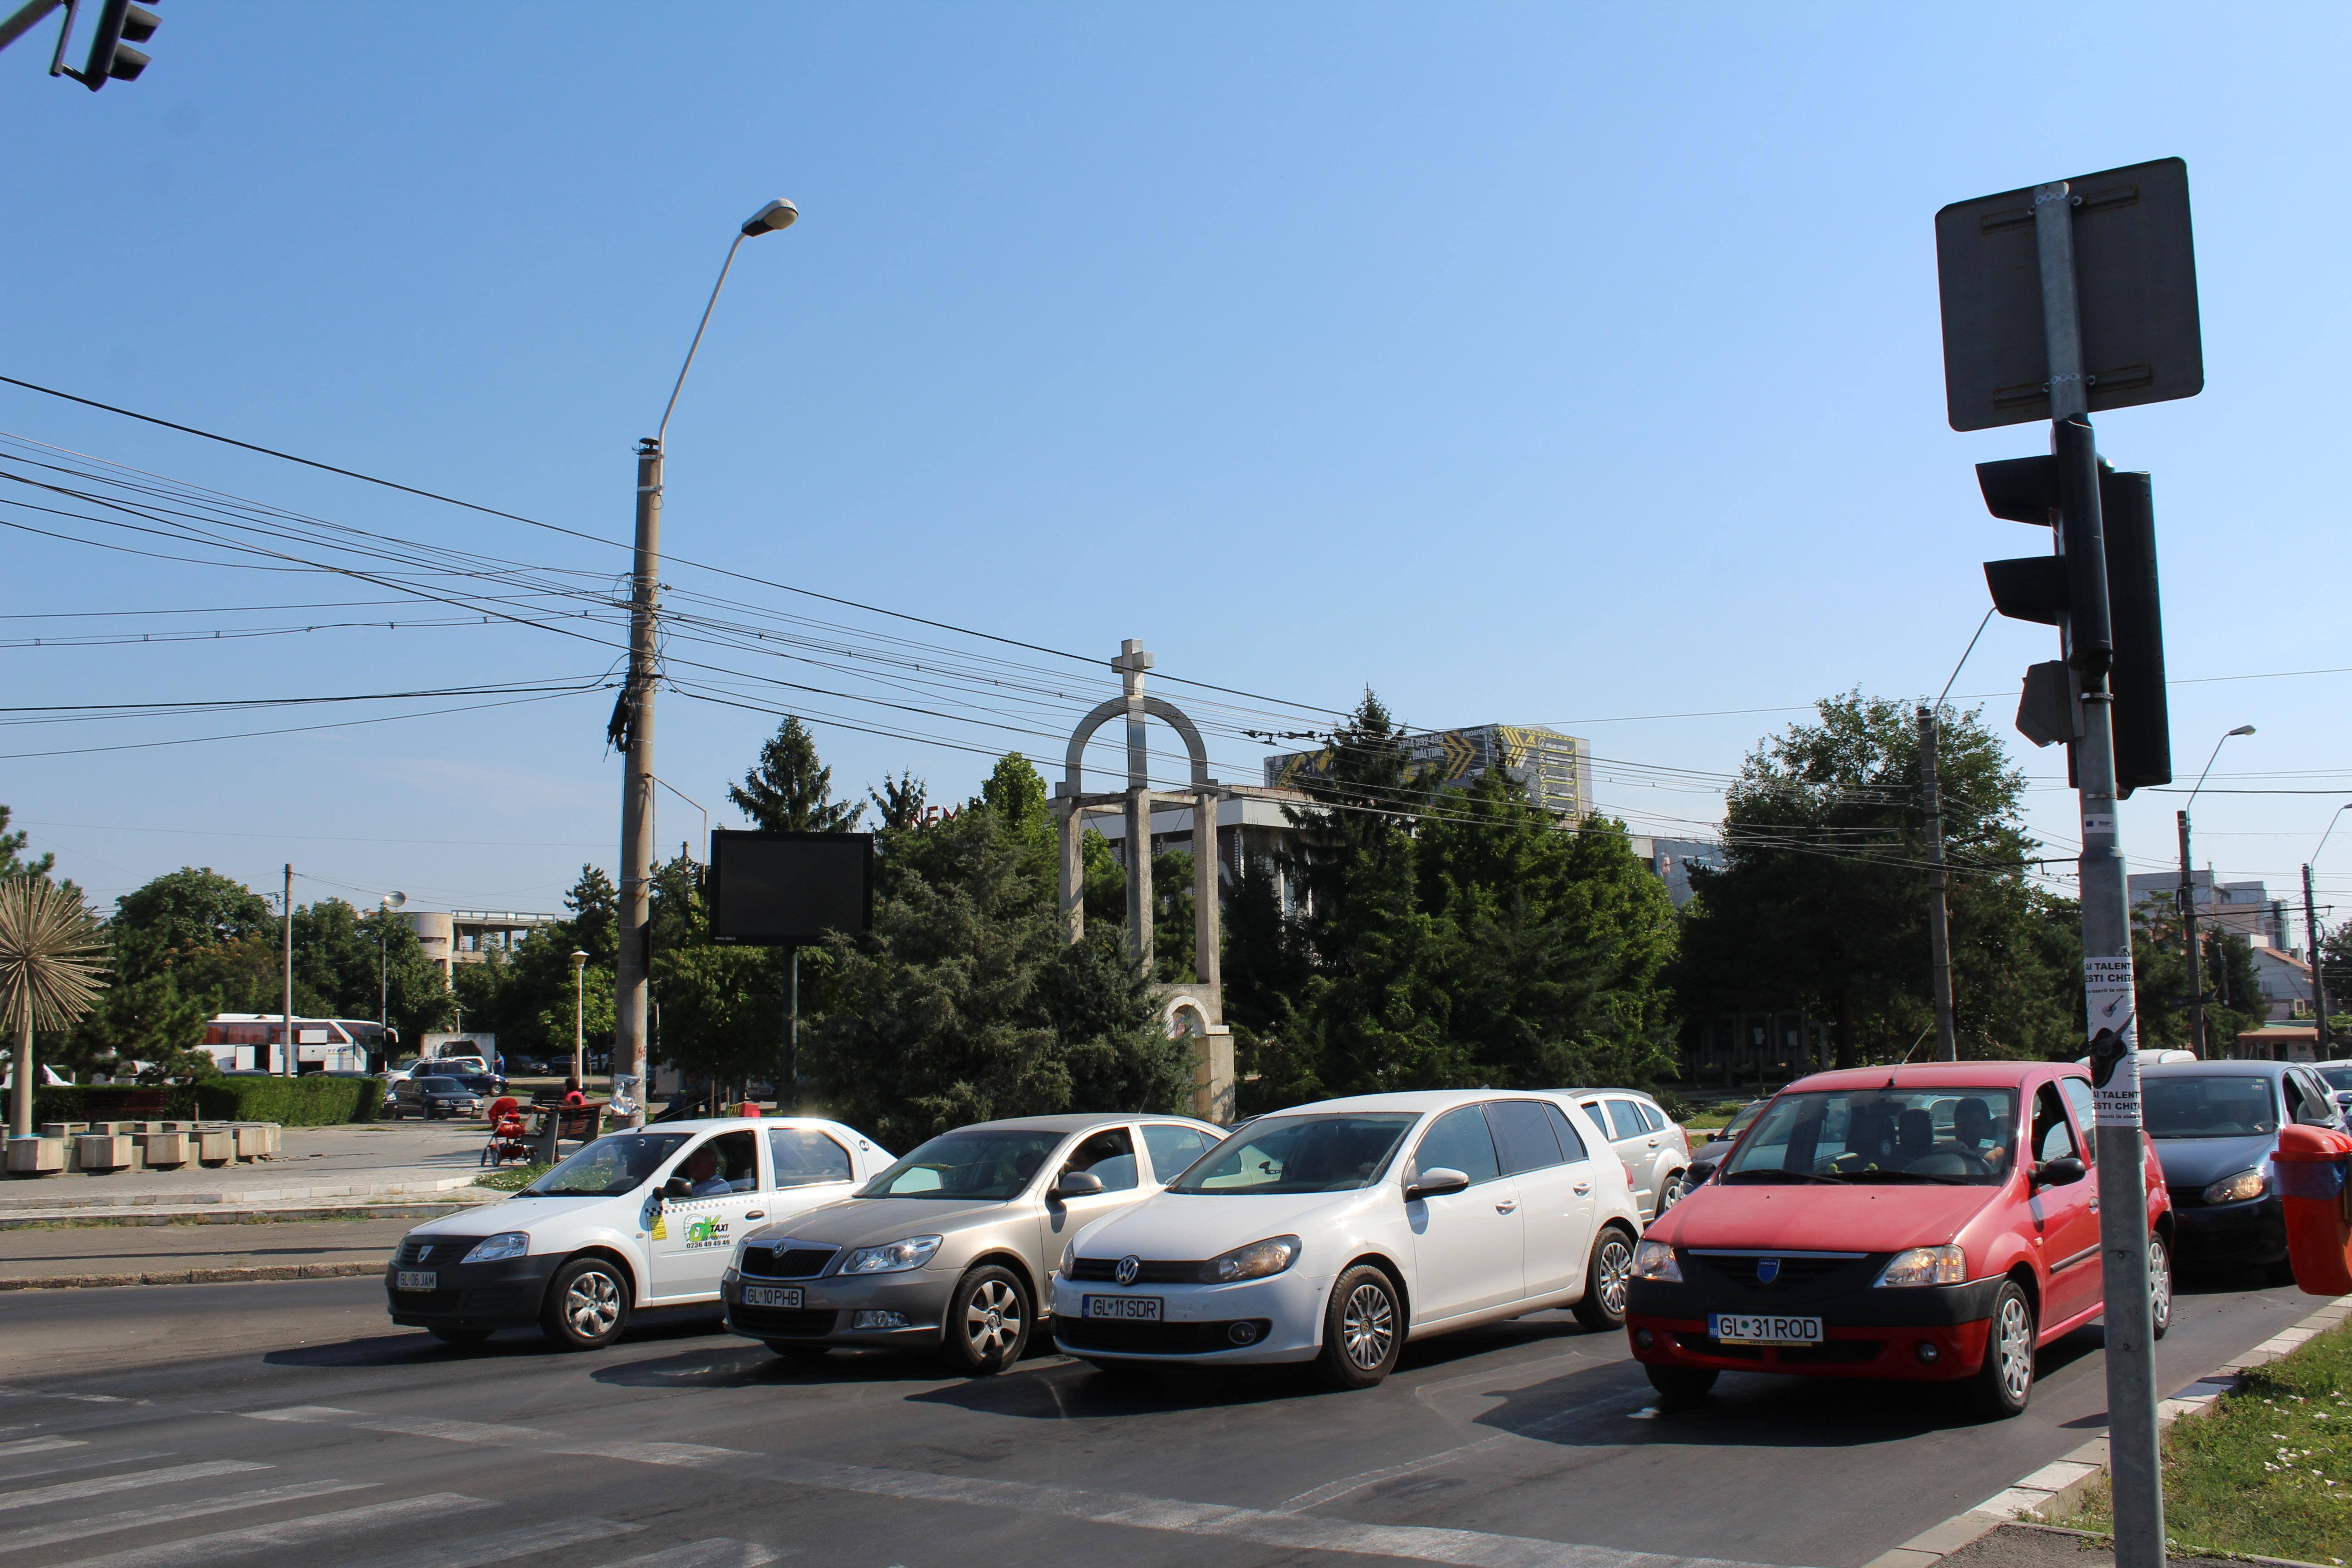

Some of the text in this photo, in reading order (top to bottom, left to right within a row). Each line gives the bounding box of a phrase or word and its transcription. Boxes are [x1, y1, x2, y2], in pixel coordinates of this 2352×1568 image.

[1416, 737, 1429, 746] 592
[1430, 734, 1444, 744] 495
[729, 1104, 741, 1116] TAXI
[690, 1215, 722, 1242] OK
[710, 1224, 729, 1232] TAXI
[401, 1273, 434, 1286] GL 06 JAM
[747, 1289, 799, 1305] GL 10 PHB
[1093, 1299, 1109, 1316] GL
[1115, 1299, 1124, 1316] 11
[1127, 1300, 1156, 1318] SDR
[1710, 1317, 1818, 1338] RO GL 31 ROD
